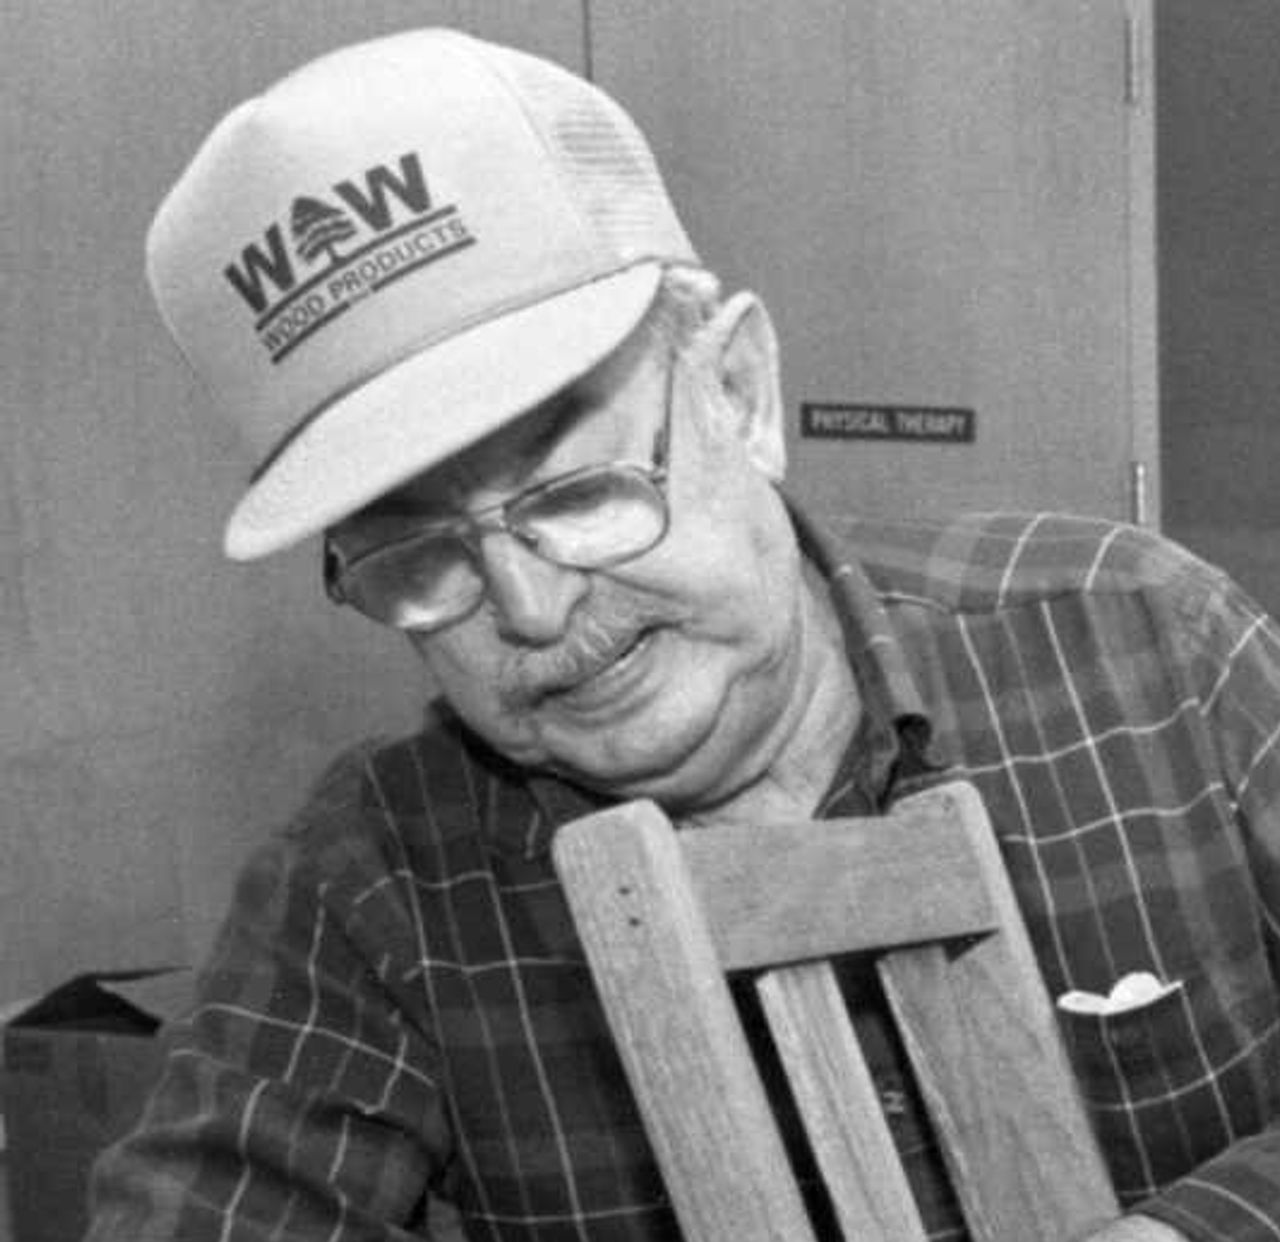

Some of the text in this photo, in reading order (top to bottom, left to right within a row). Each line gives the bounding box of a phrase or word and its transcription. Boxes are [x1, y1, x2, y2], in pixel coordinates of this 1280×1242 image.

[260, 217, 470, 352] WOOD PRODUCTS
[811, 408, 967, 434] PHYSICAL THERAPY
